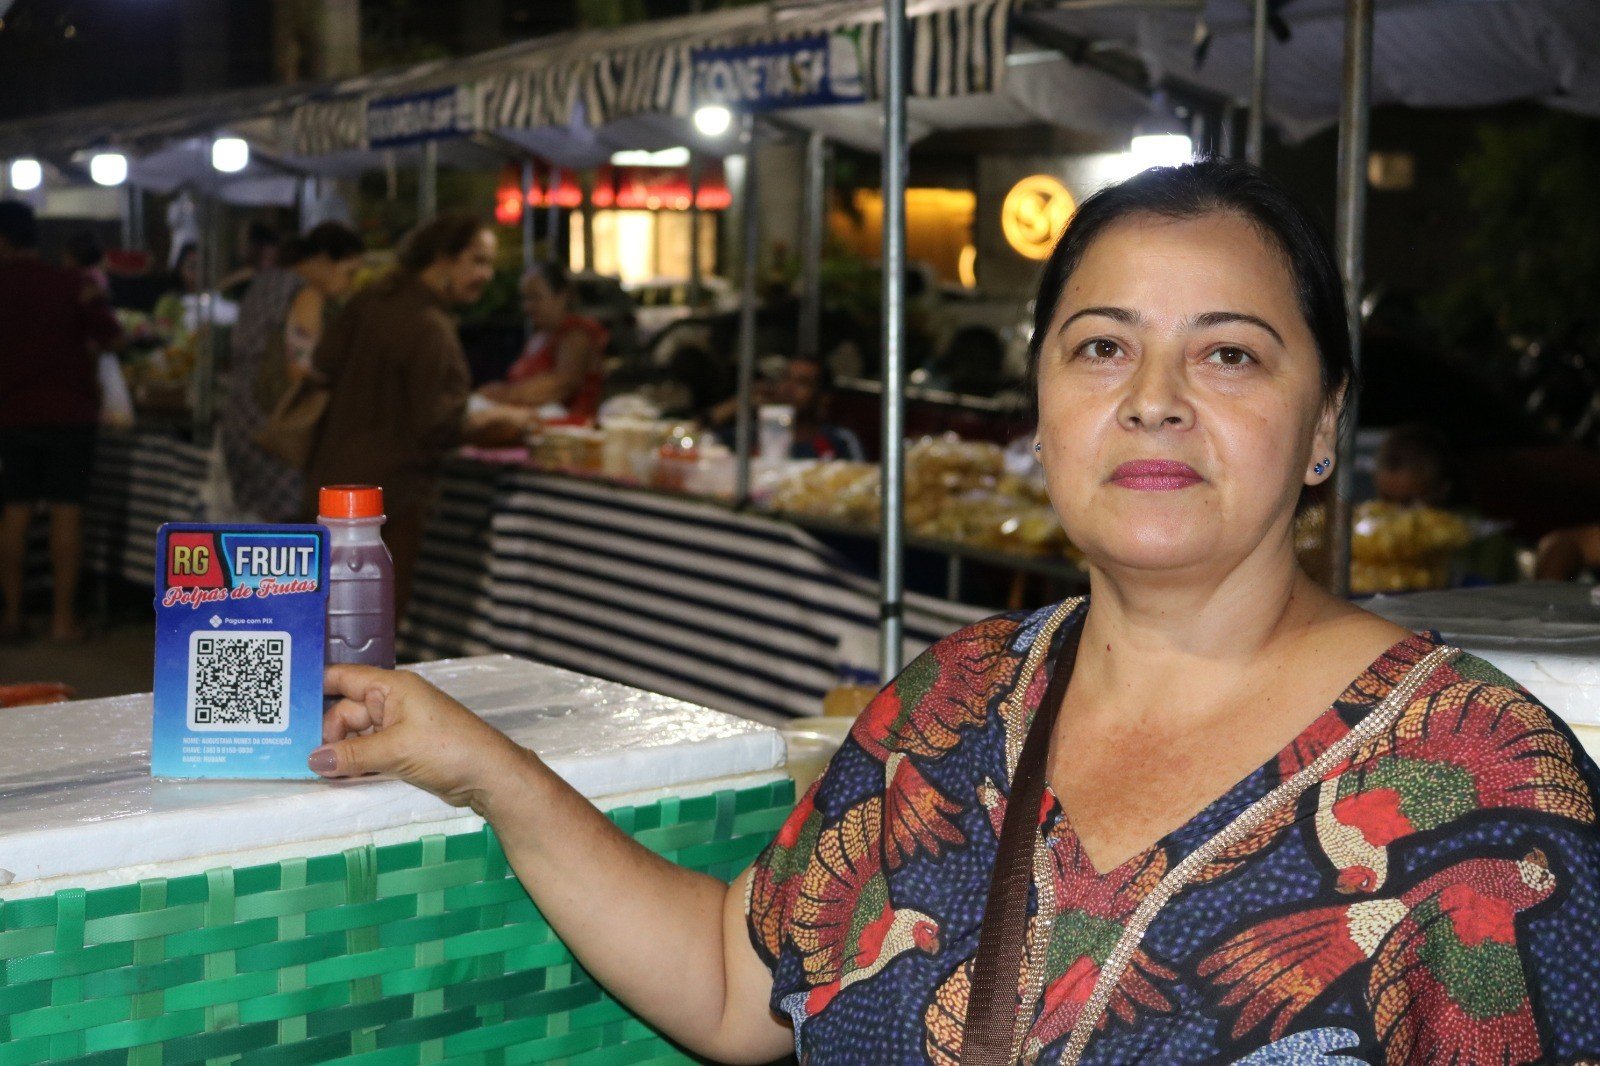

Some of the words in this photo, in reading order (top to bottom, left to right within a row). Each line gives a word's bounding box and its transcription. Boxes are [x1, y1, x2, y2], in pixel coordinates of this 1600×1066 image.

[173, 546, 209, 575] RG
[236, 546, 314, 576] FRUIT
[162, 586, 228, 609] Polpas
[231, 582, 253, 599] de
[256, 577, 316, 598] Frutas
[225, 617, 246, 625] Pague
[252, 737, 260, 745] DA
